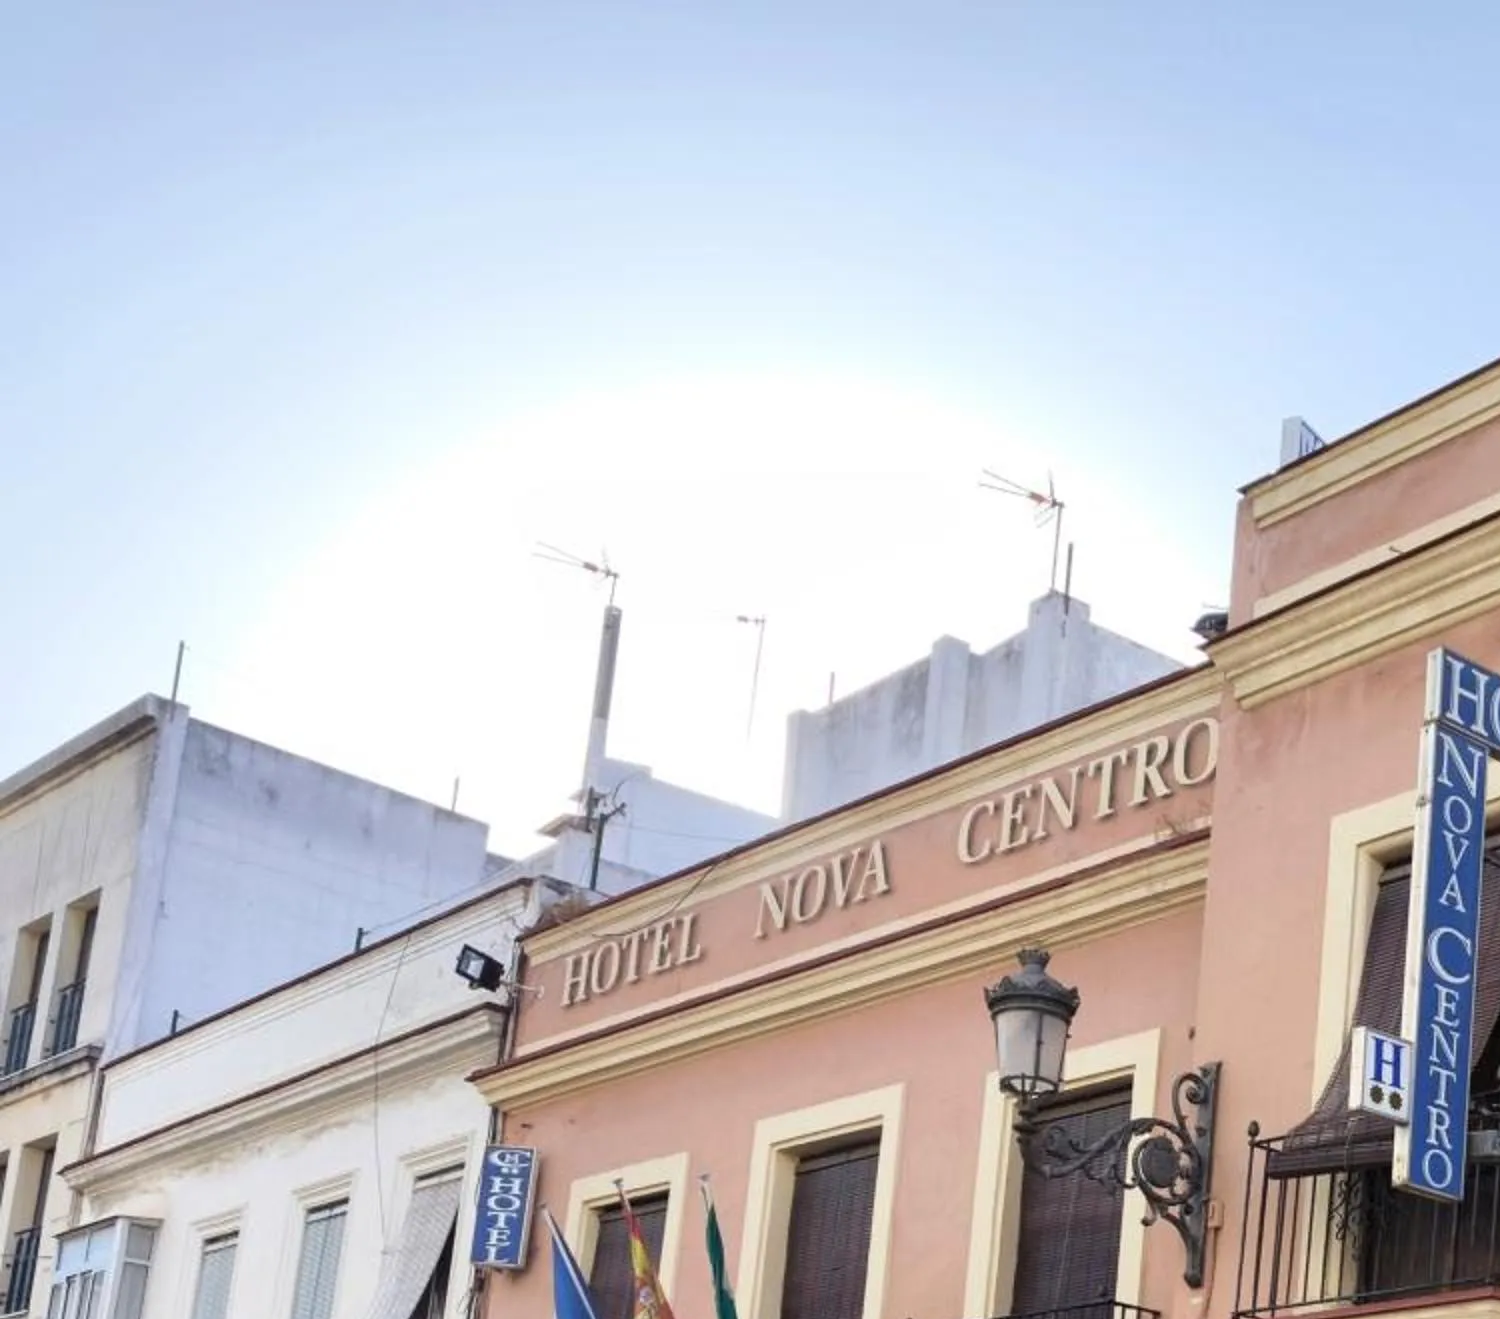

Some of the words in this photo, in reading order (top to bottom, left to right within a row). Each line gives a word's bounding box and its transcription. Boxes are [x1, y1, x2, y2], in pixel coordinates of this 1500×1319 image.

[560, 913, 702, 1008] HOTEL
[754, 839, 892, 940] NOVA
[957, 717, 1219, 864] CENTRO
[1437, 732, 1484, 913] NOVA
[1369, 1035, 1407, 1090] H
[1421, 926, 1472, 1189] CENTRO
[485, 1176, 525, 1264] HOTEL
